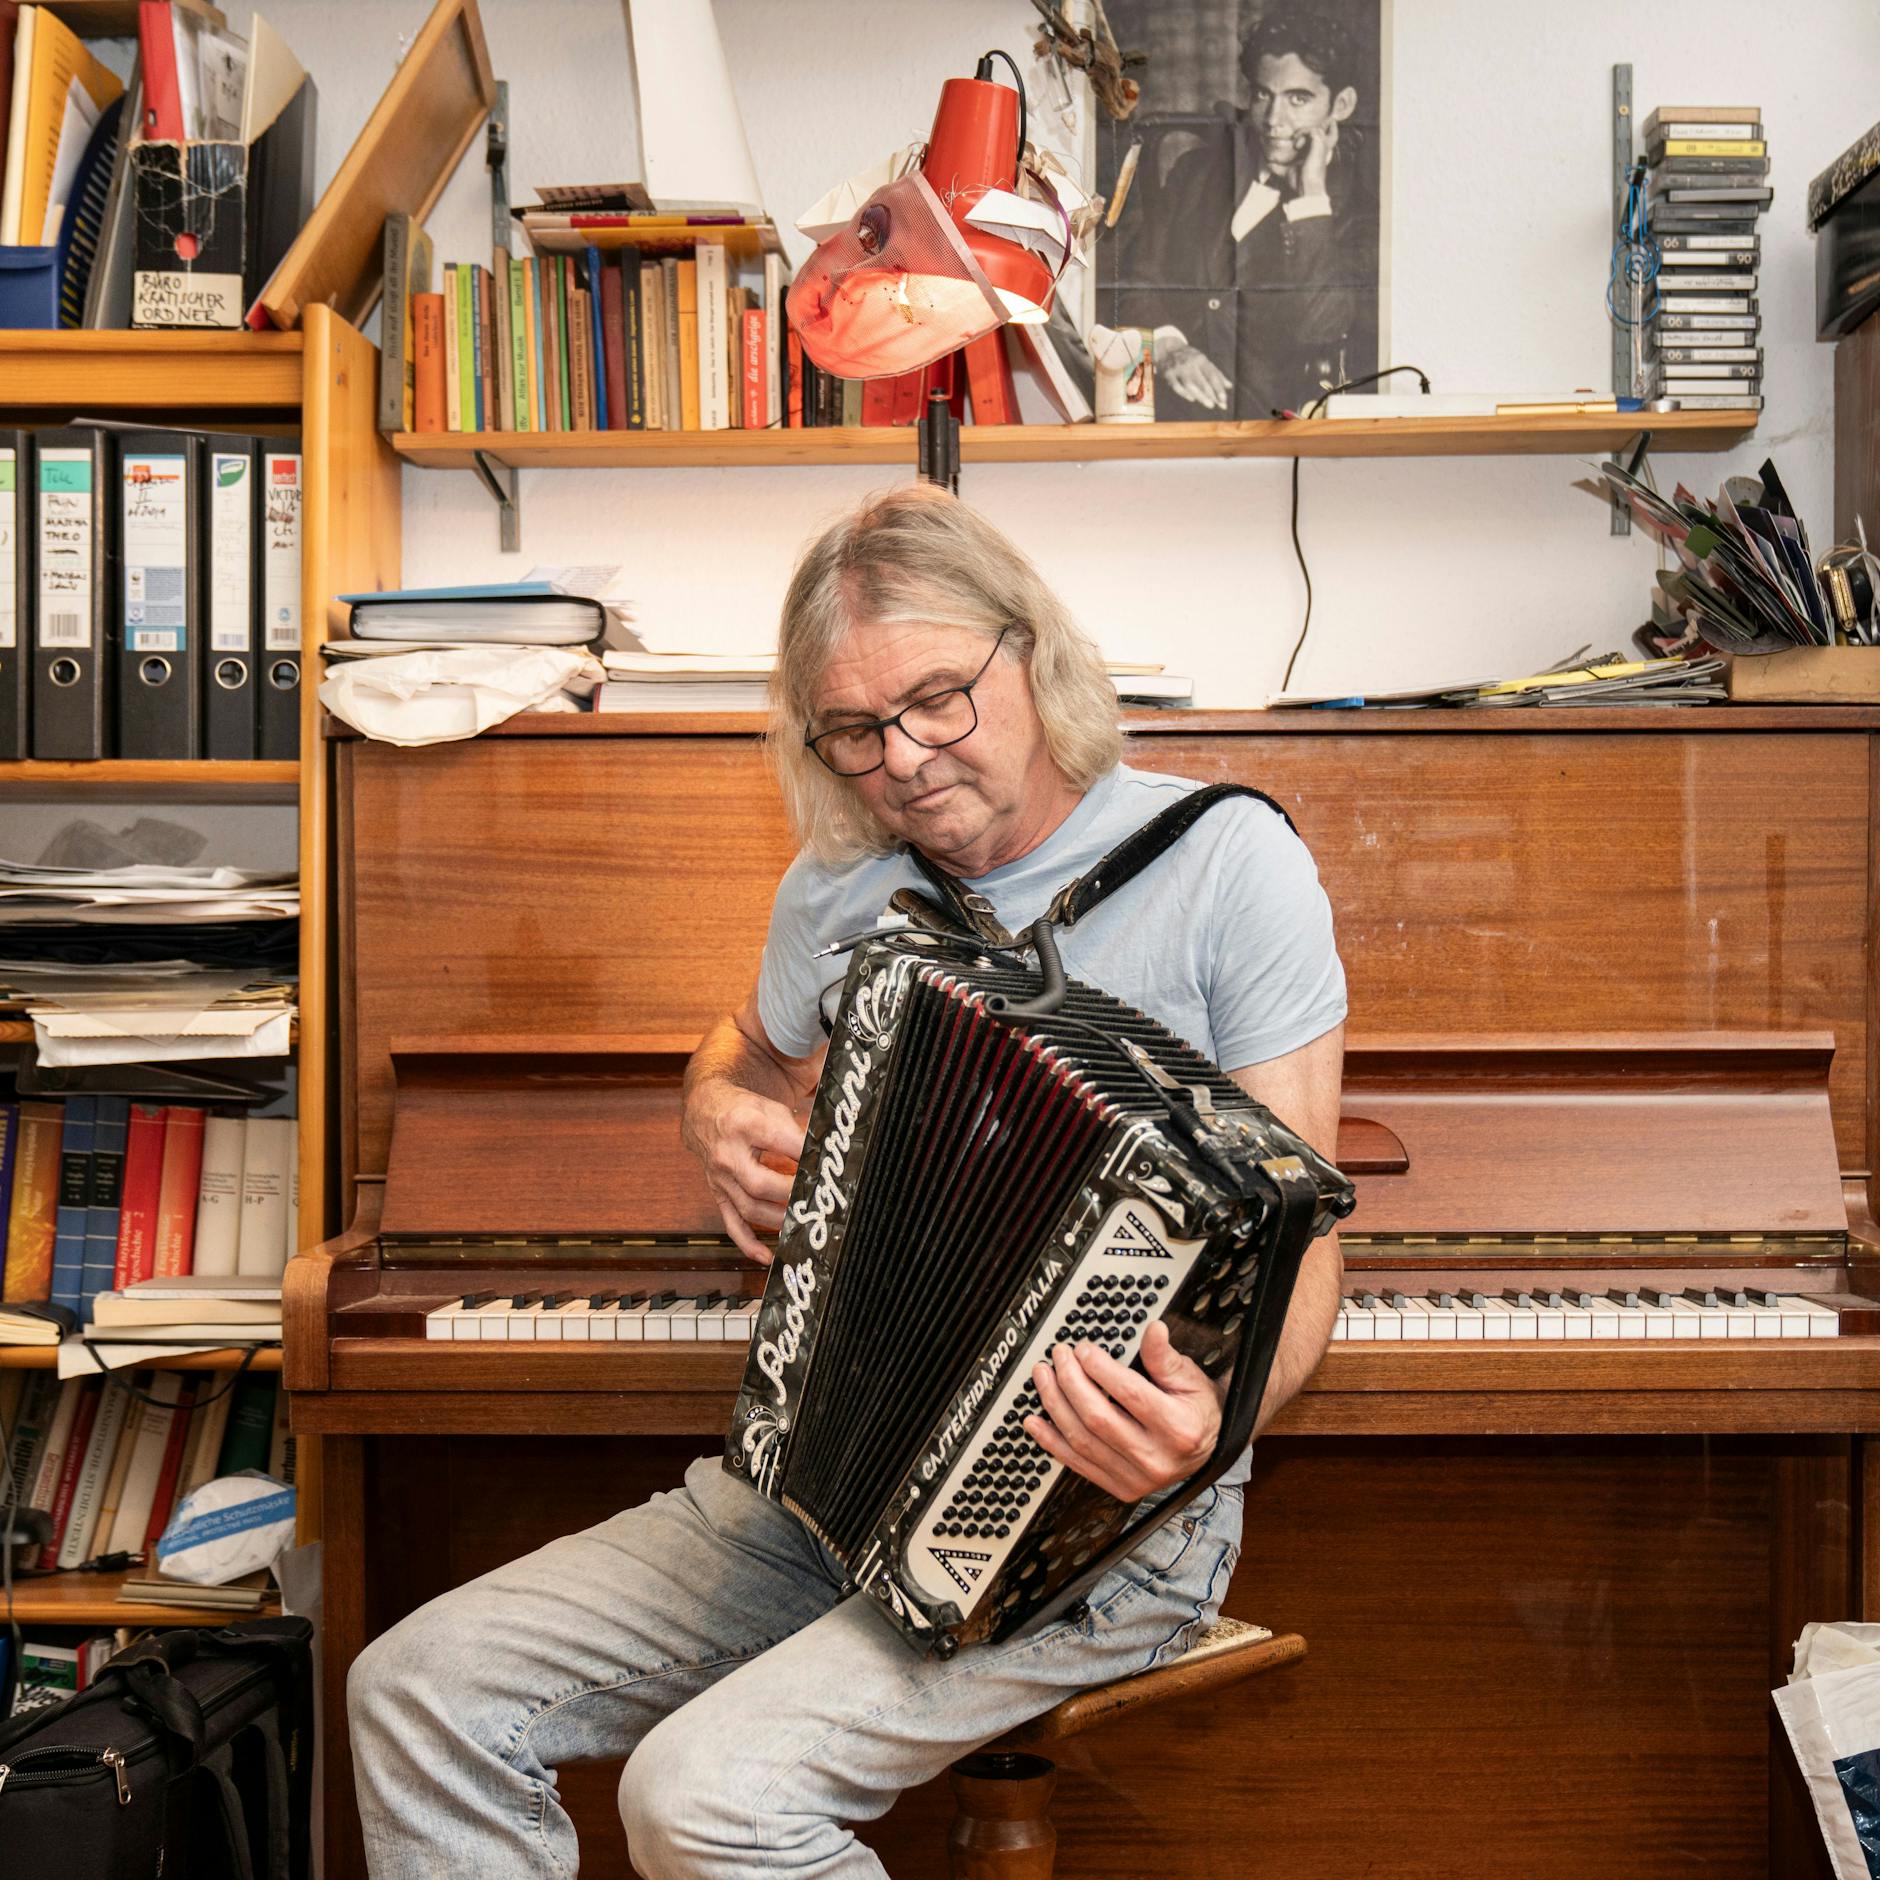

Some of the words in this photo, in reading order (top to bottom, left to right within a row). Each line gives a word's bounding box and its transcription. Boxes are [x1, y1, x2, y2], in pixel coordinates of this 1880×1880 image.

[1736, 253, 1752, 265] 90
[514, 285, 523, 306] Band
[142, 307, 222, 326] ORDNER
[388, 316, 399, 332] auf
[516, 336, 525, 361] Musik
[746, 314, 762, 366] arschgeige
[518, 363, 526, 377] zur
[748, 367, 758, 383] die
[1739, 365, 1755, 377] 90
[518, 379, 527, 400] Atlas
[45, 531, 81, 541] THEO
[244, 1195, 265, 1205] H-P
[757, 1256, 817, 1407] Paolo
[793, 1039, 872, 1250] Soprani
[169, 1232, 184, 1277] eschichte
[922, 1327, 1018, 1480] CASTELFIDARDO
[1016, 1258, 1065, 1328] ITALIA
[222, 1496, 290, 1520] Schutzmaske
